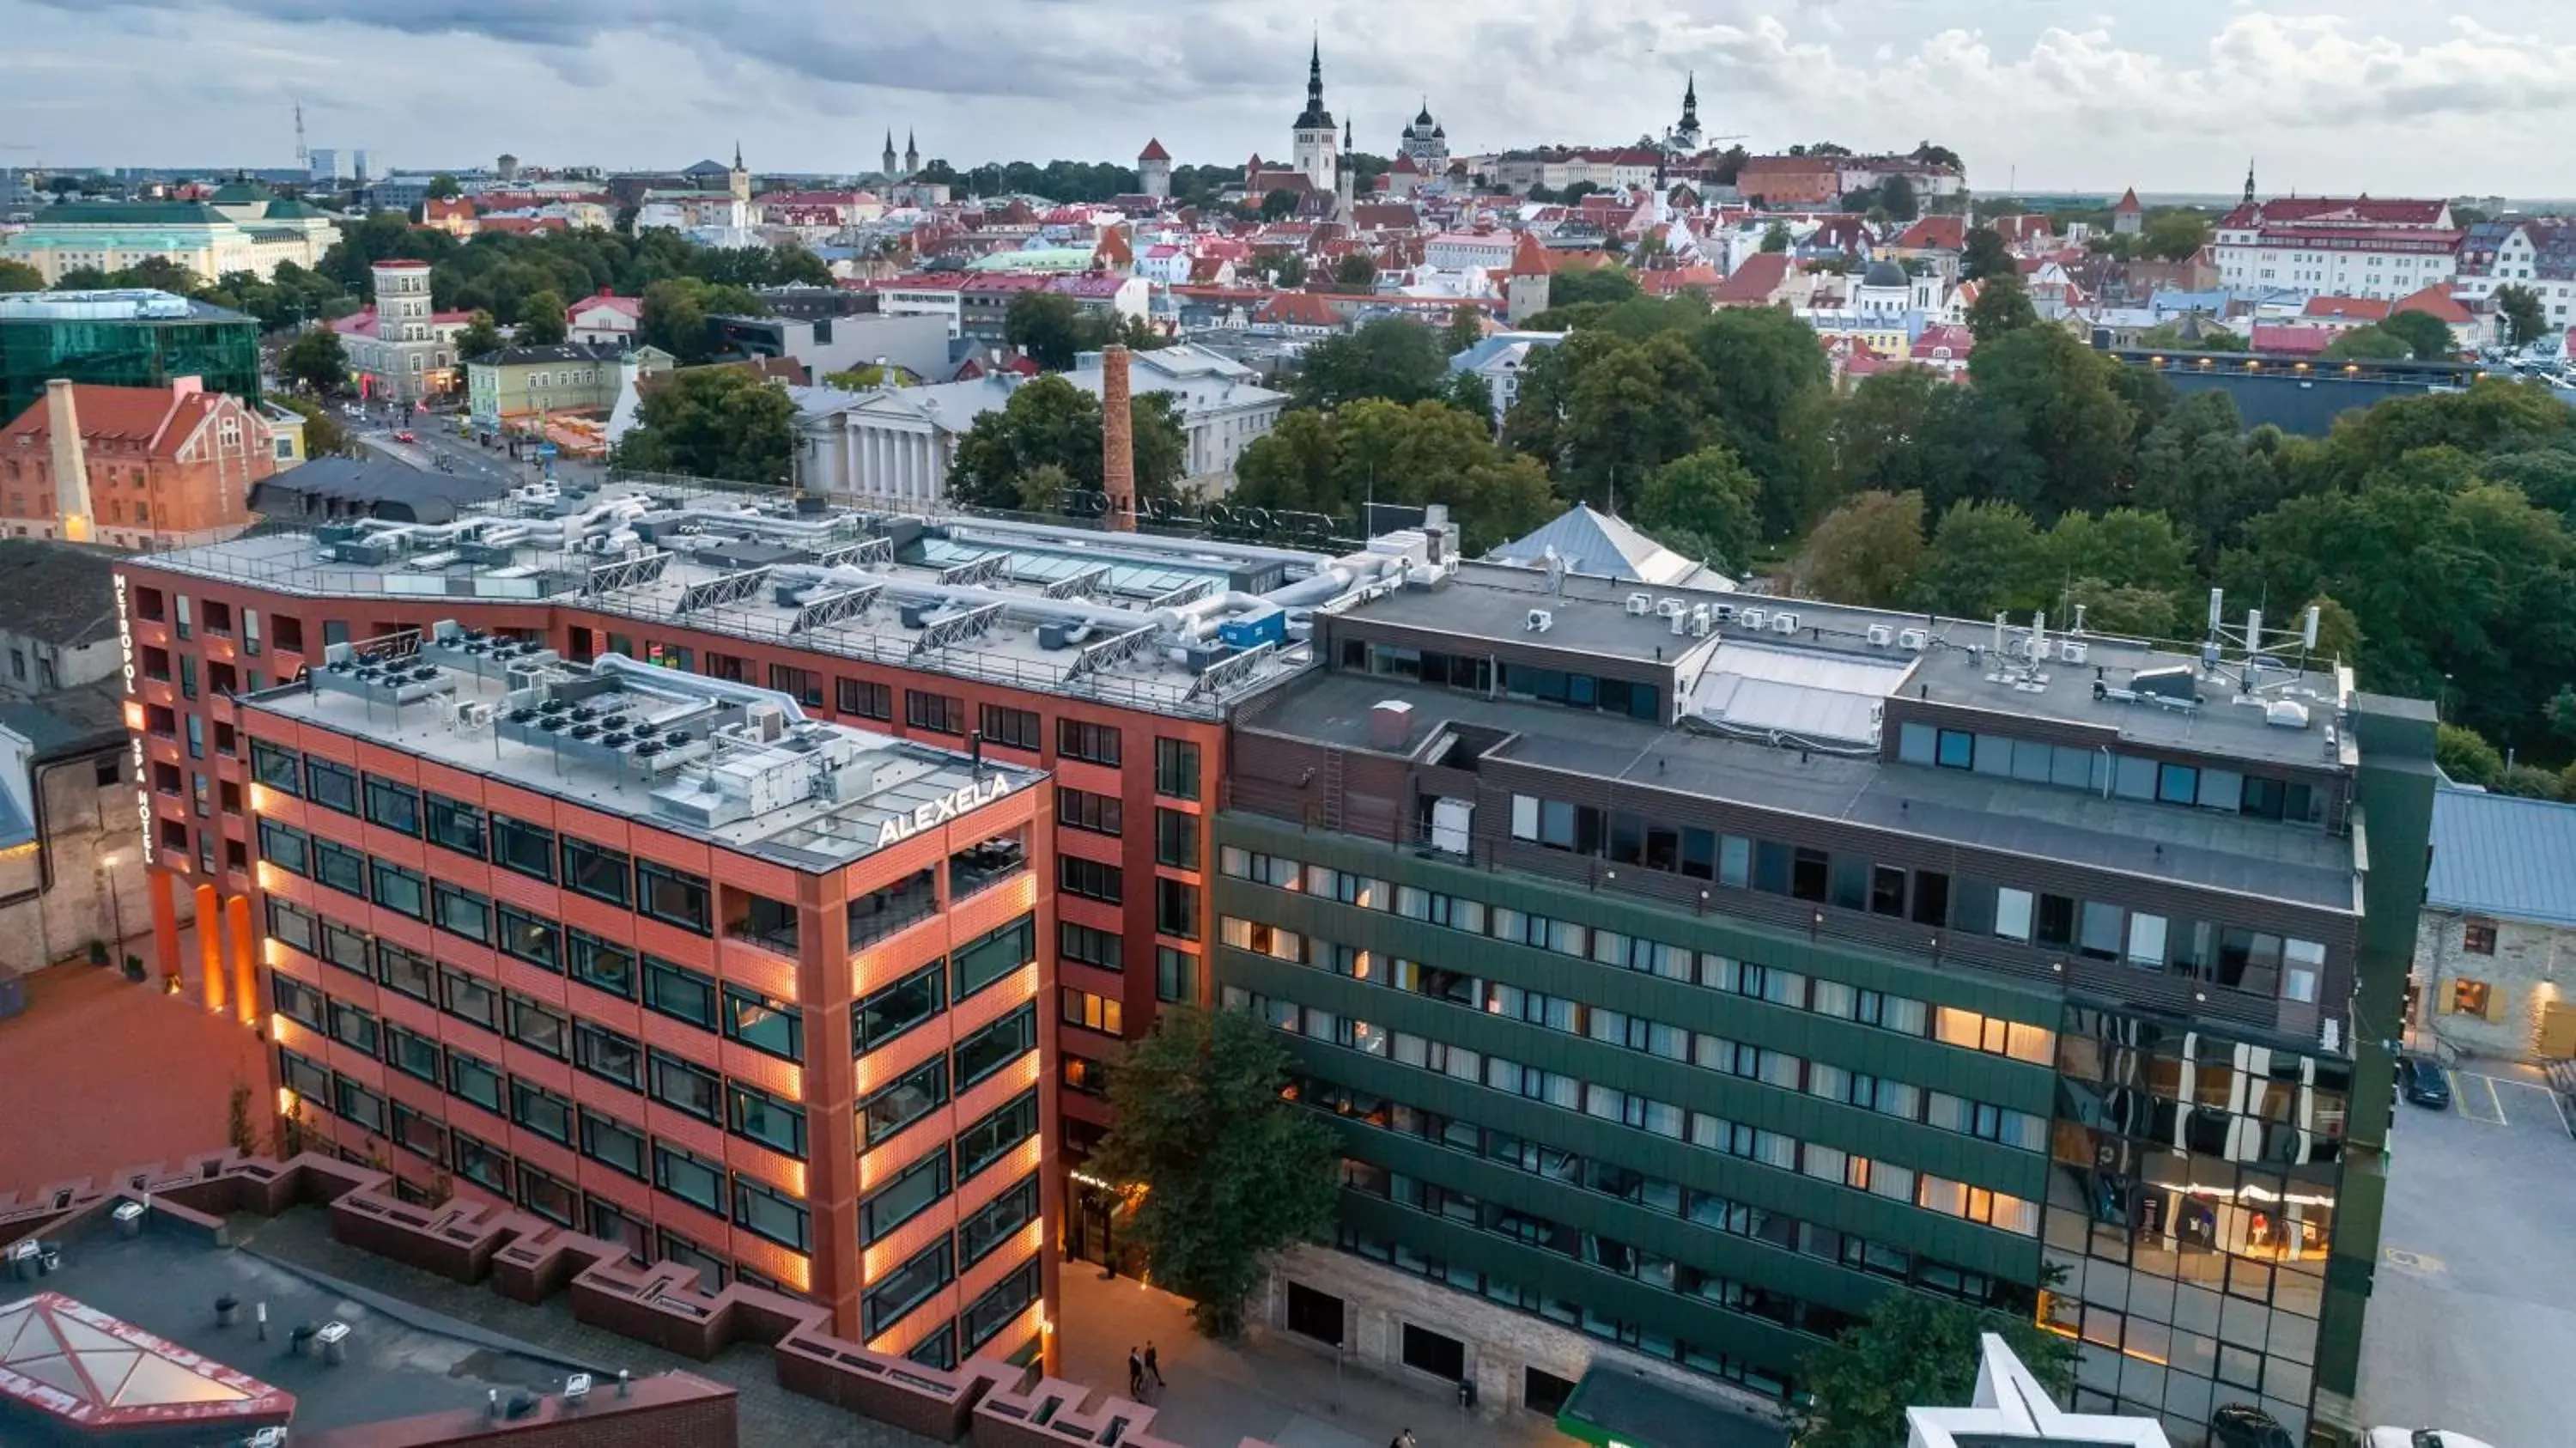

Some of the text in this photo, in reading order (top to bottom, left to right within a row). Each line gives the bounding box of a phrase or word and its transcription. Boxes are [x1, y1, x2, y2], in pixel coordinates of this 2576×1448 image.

[113, 574, 154, 864] METROPOL SPA HOTEL
[877, 773, 1010, 848] ALEXELA
